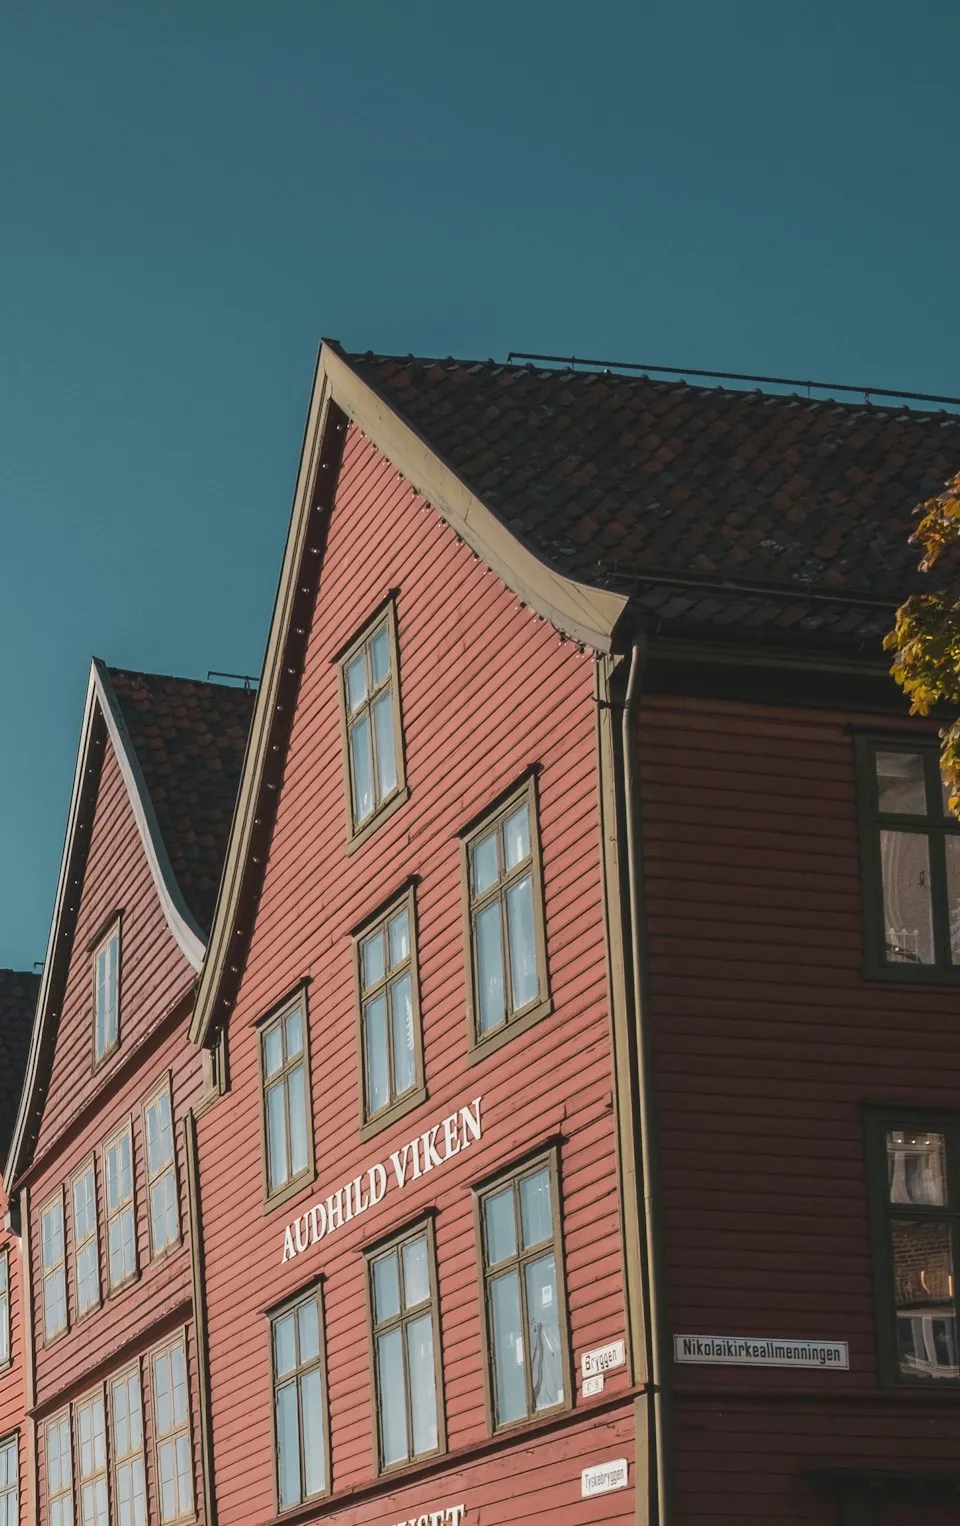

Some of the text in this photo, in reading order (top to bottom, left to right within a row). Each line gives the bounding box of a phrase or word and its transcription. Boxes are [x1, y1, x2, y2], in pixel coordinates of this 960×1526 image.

[281, 1096, 482, 1265] AUDHILD VIKEN
[585, 1349, 617, 1372] Bryggen
[683, 1338, 841, 1365] Nikolaikirkeallmenningen
[584, 1468, 624, 1493] Tyskebryggen
